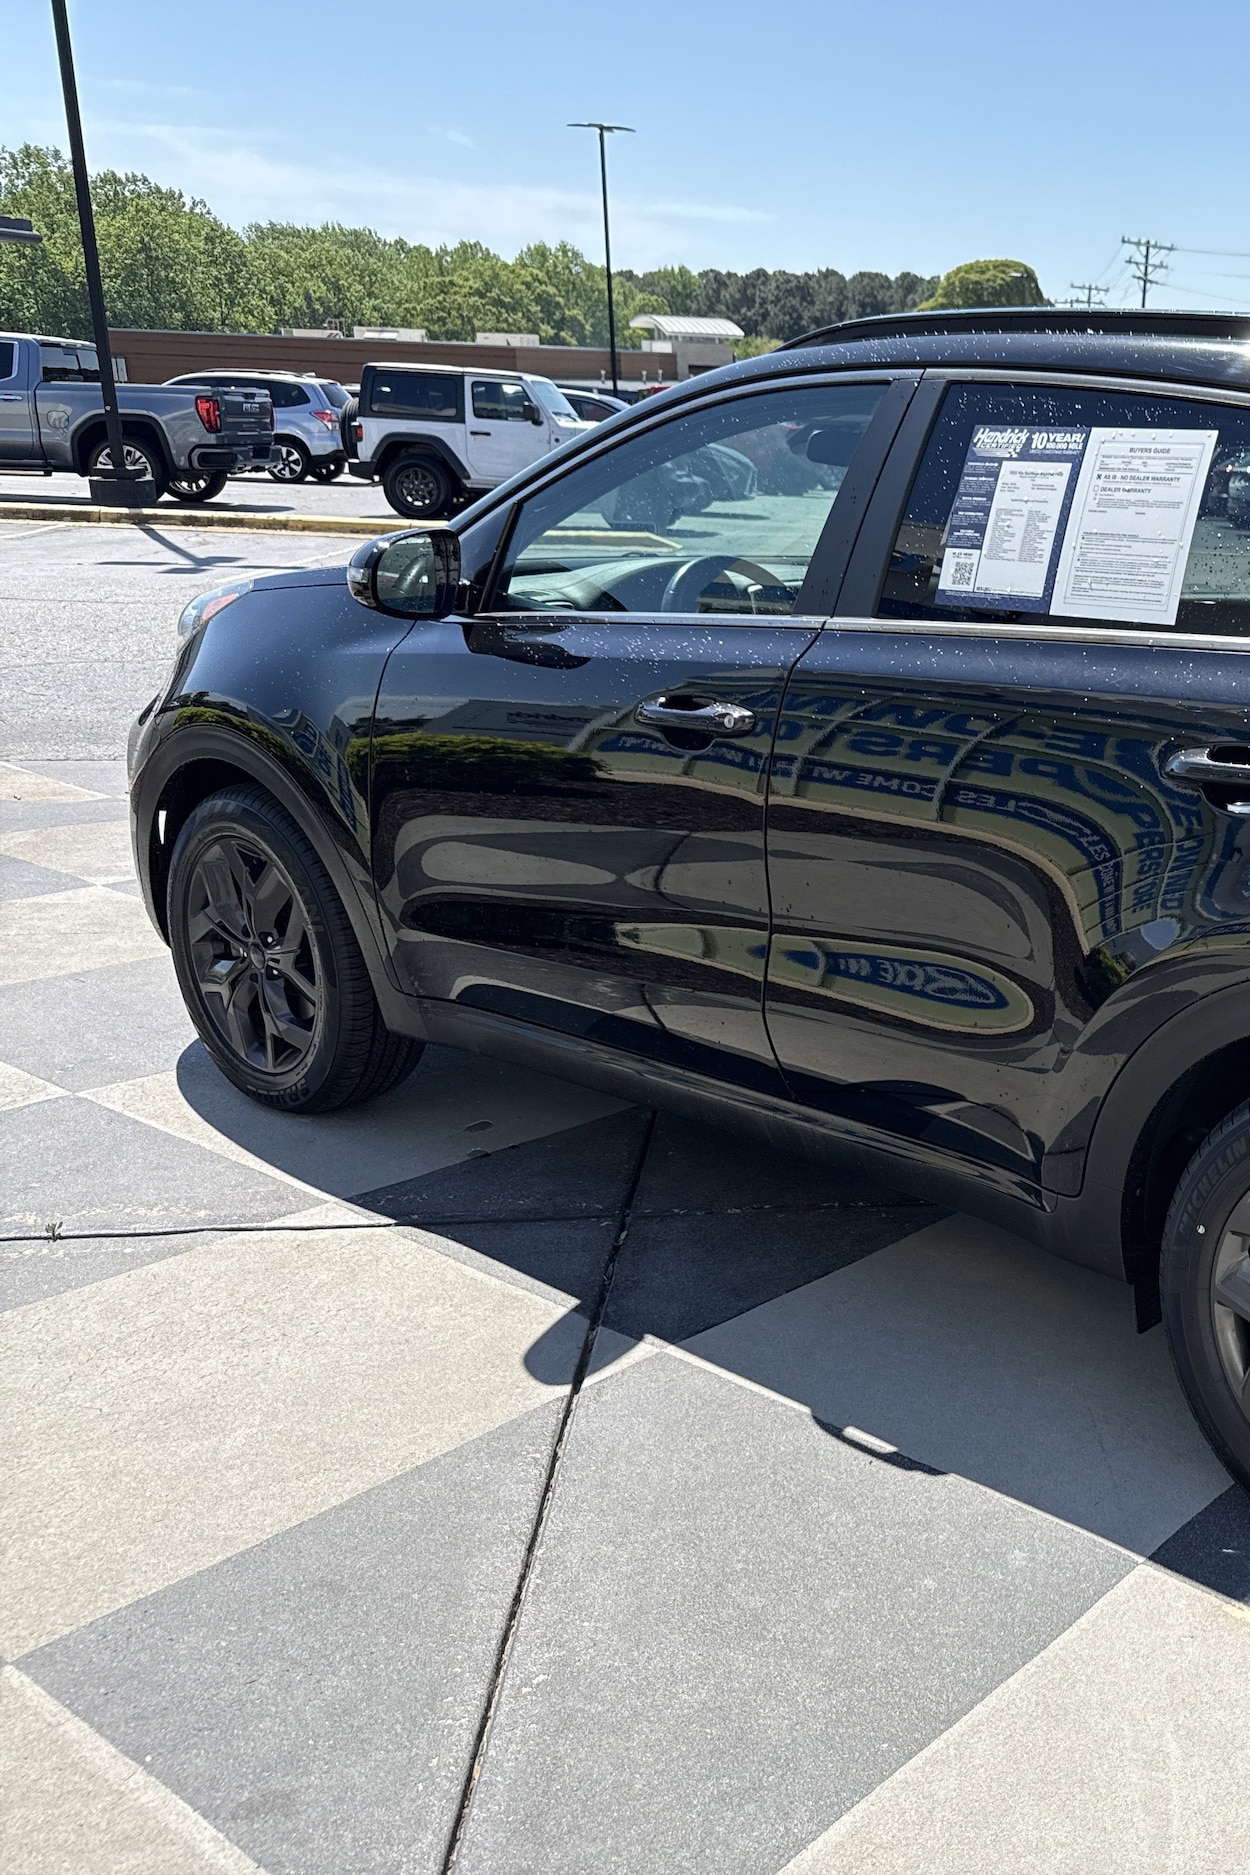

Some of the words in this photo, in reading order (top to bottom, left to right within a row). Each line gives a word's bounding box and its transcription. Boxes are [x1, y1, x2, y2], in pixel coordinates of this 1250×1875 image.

[973, 428, 1030, 448] Hendrick
[980, 442, 1024, 450] CERTIFIED
[1031, 432, 1048, 450] 10
[1178, 1135, 1250, 1242] MICHELIN
